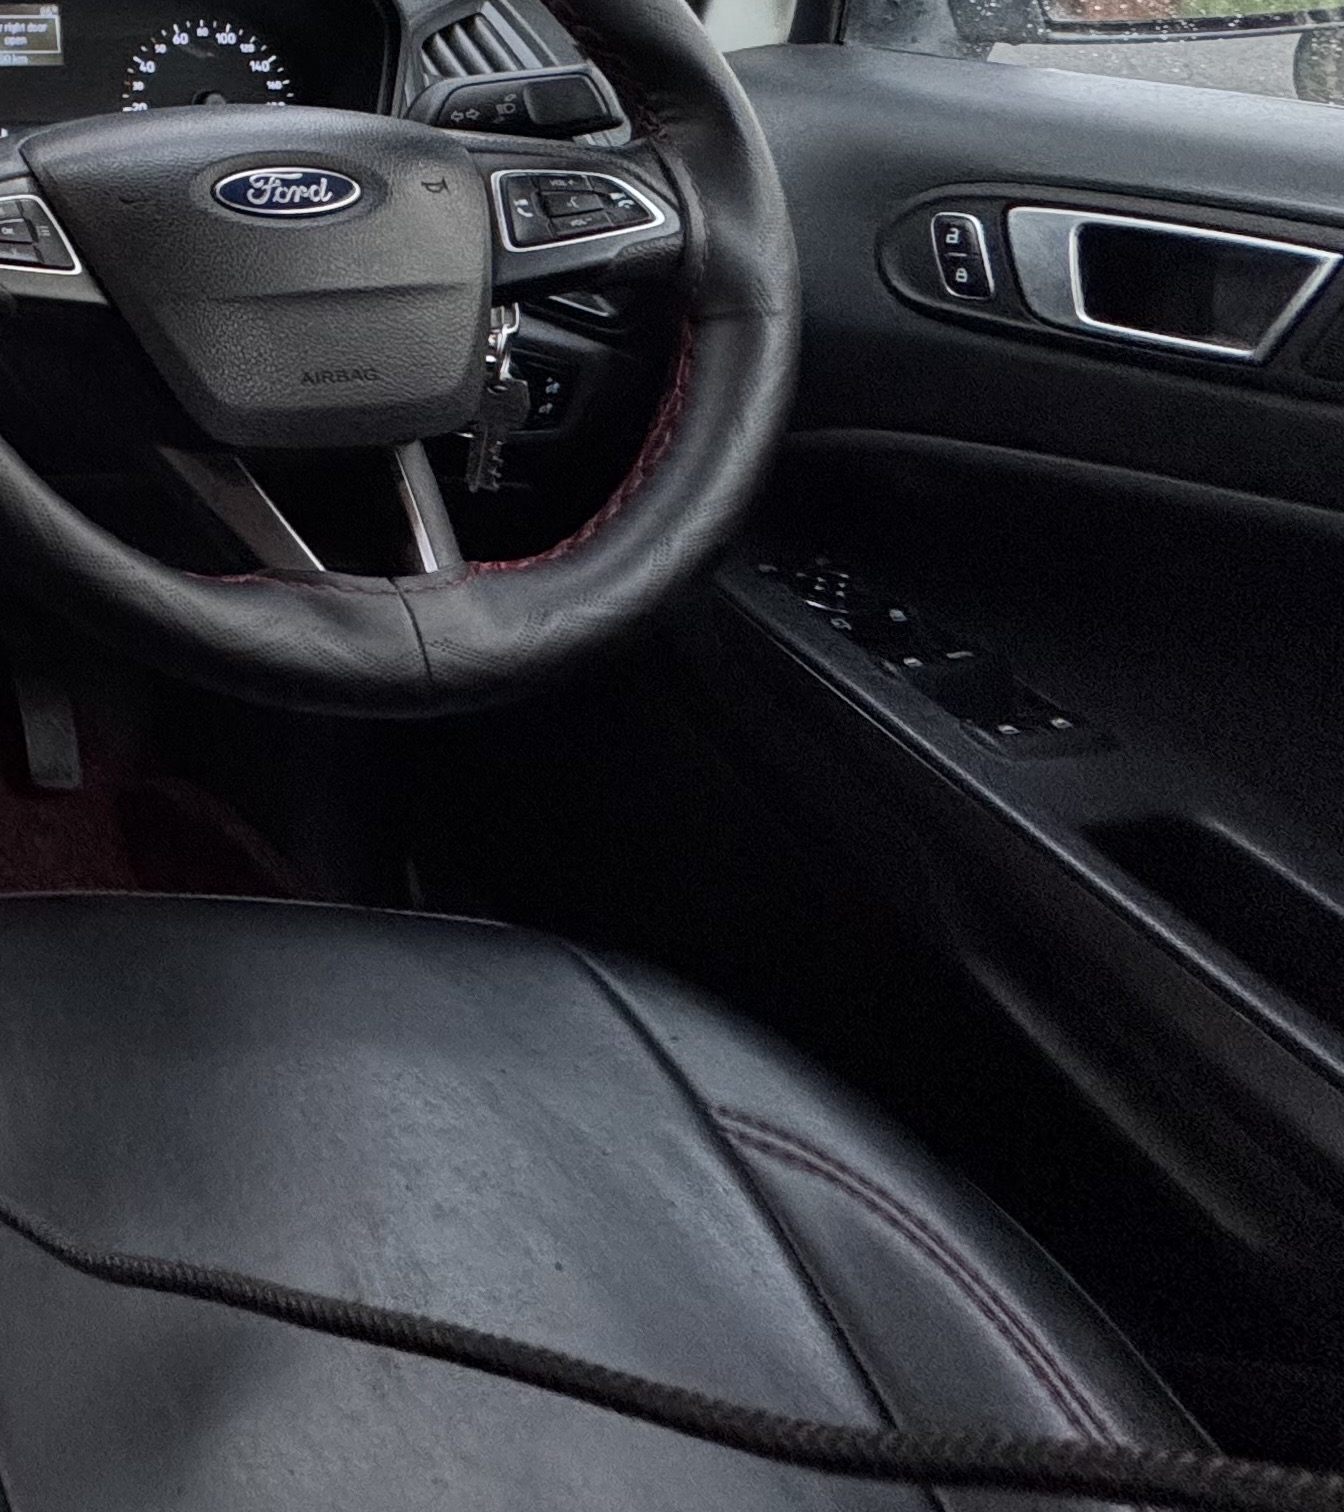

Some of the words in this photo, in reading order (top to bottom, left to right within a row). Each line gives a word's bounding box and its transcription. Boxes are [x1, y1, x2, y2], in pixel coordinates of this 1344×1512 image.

[4, 22, 26, 34] right
[27, 22, 48, 33] door
[196, 27, 209, 37] 80
[4, 36, 28, 46] open
[172, 32, 189, 45] 60
[215, 32, 237, 45] 100
[154, 43, 167, 54] 50
[240, 43, 255, 53] 120
[139, 60, 156, 73] 40
[249, 60, 270, 73] 140
[132, 81, 145, 91] 30
[266, 80, 282, 90] 160
[247, 173, 333, 205] Ford
[301, 368, 380, 384] AIRBAG
